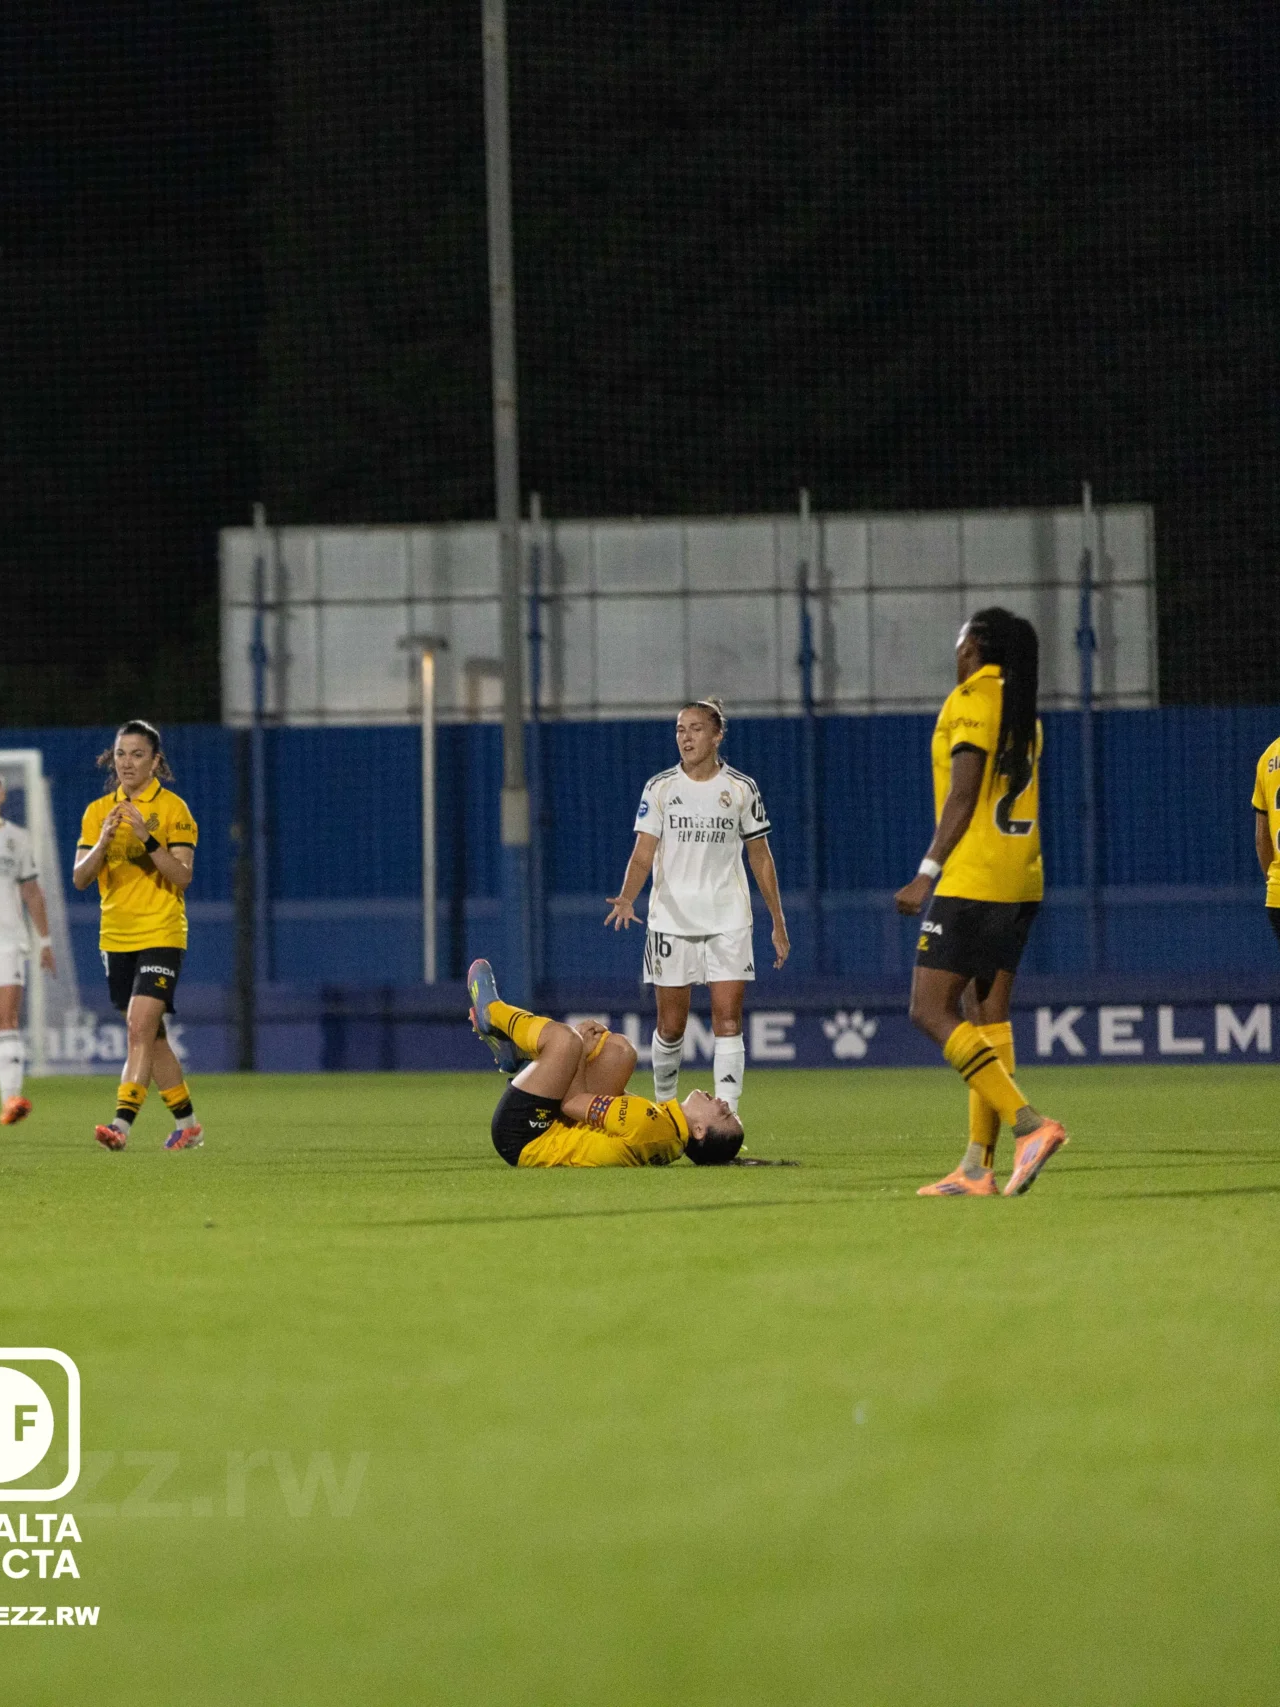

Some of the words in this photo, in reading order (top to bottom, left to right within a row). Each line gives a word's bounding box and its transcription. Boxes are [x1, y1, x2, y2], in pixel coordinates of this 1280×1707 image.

[995, 748, 1035, 836] 2
[669, 814, 735, 830] Emirates
[678, 831, 692, 842] FLY
[654, 931, 672, 958] 16
